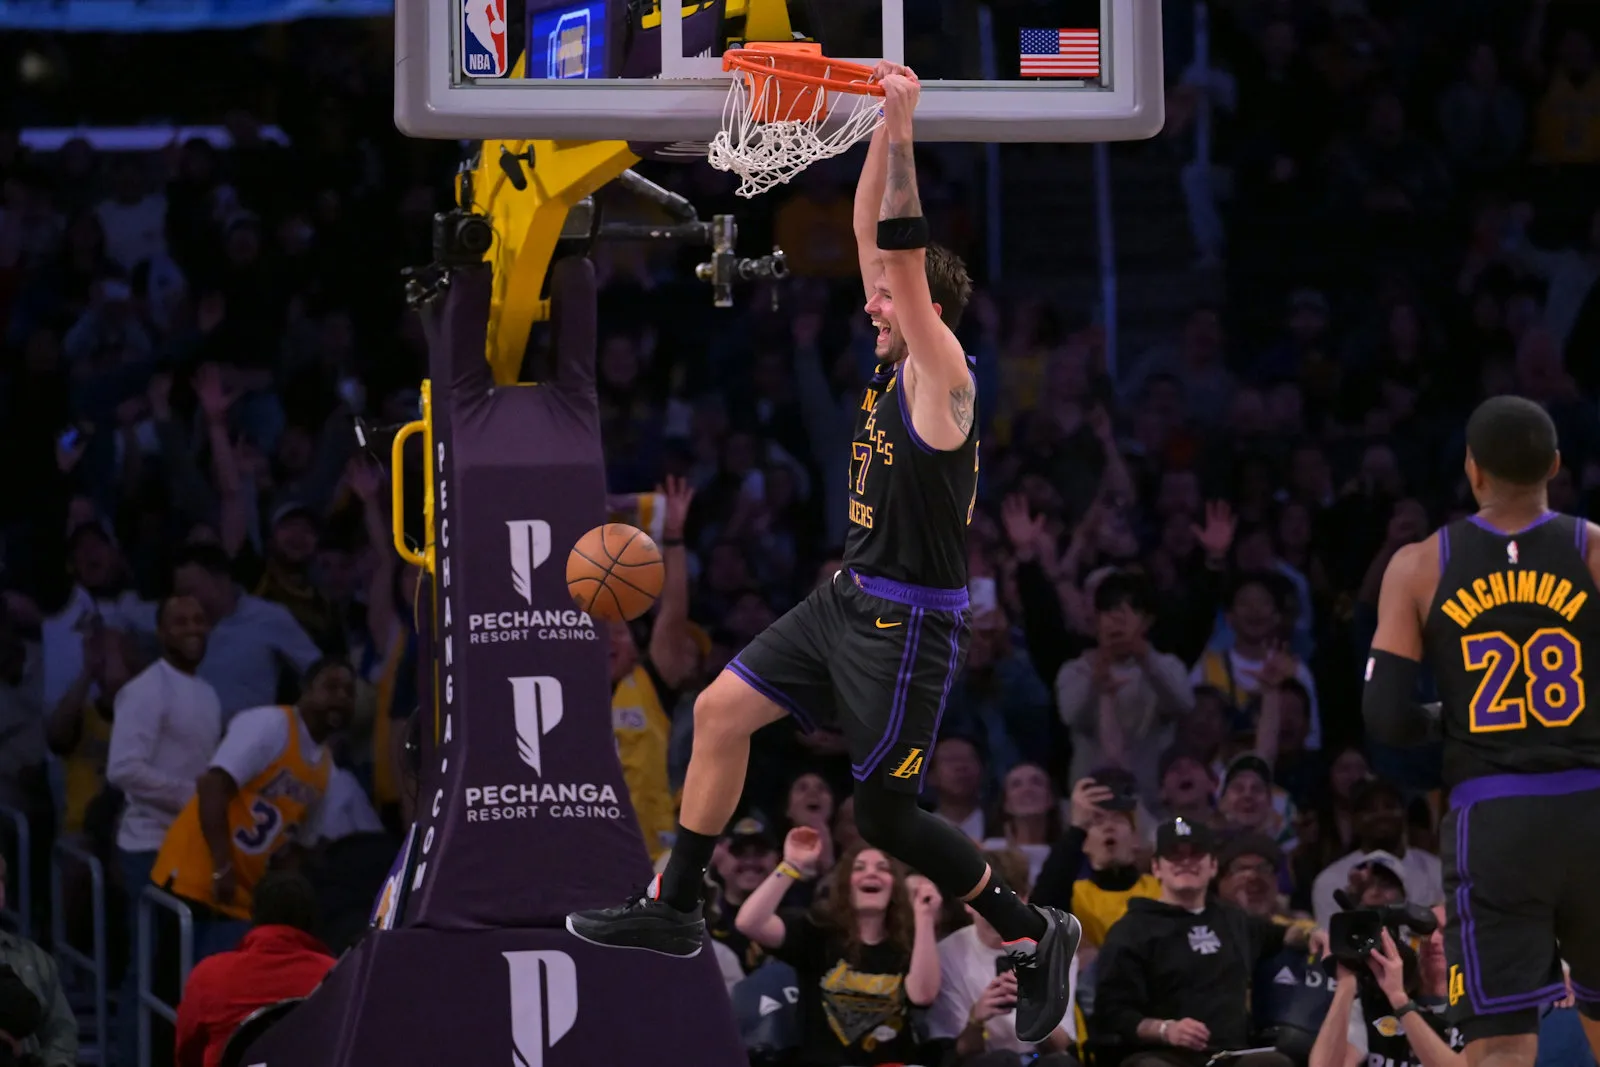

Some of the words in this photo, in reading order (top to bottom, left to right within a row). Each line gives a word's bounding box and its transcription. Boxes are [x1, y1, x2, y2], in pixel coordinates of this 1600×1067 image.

[469, 53, 491, 70] NBA
[848, 440, 873, 496] 7
[1440, 570, 1588, 629] HACHIMURA
[469, 609, 594, 631] PECHANGA
[470, 629, 529, 644] RESORT
[538, 628, 596, 641] CASINO
[1460, 627, 1586, 733] 28
[465, 783, 619, 807] PECHANGA
[467, 805, 539, 822] RESORT
[549, 805, 621, 820] CASINO
